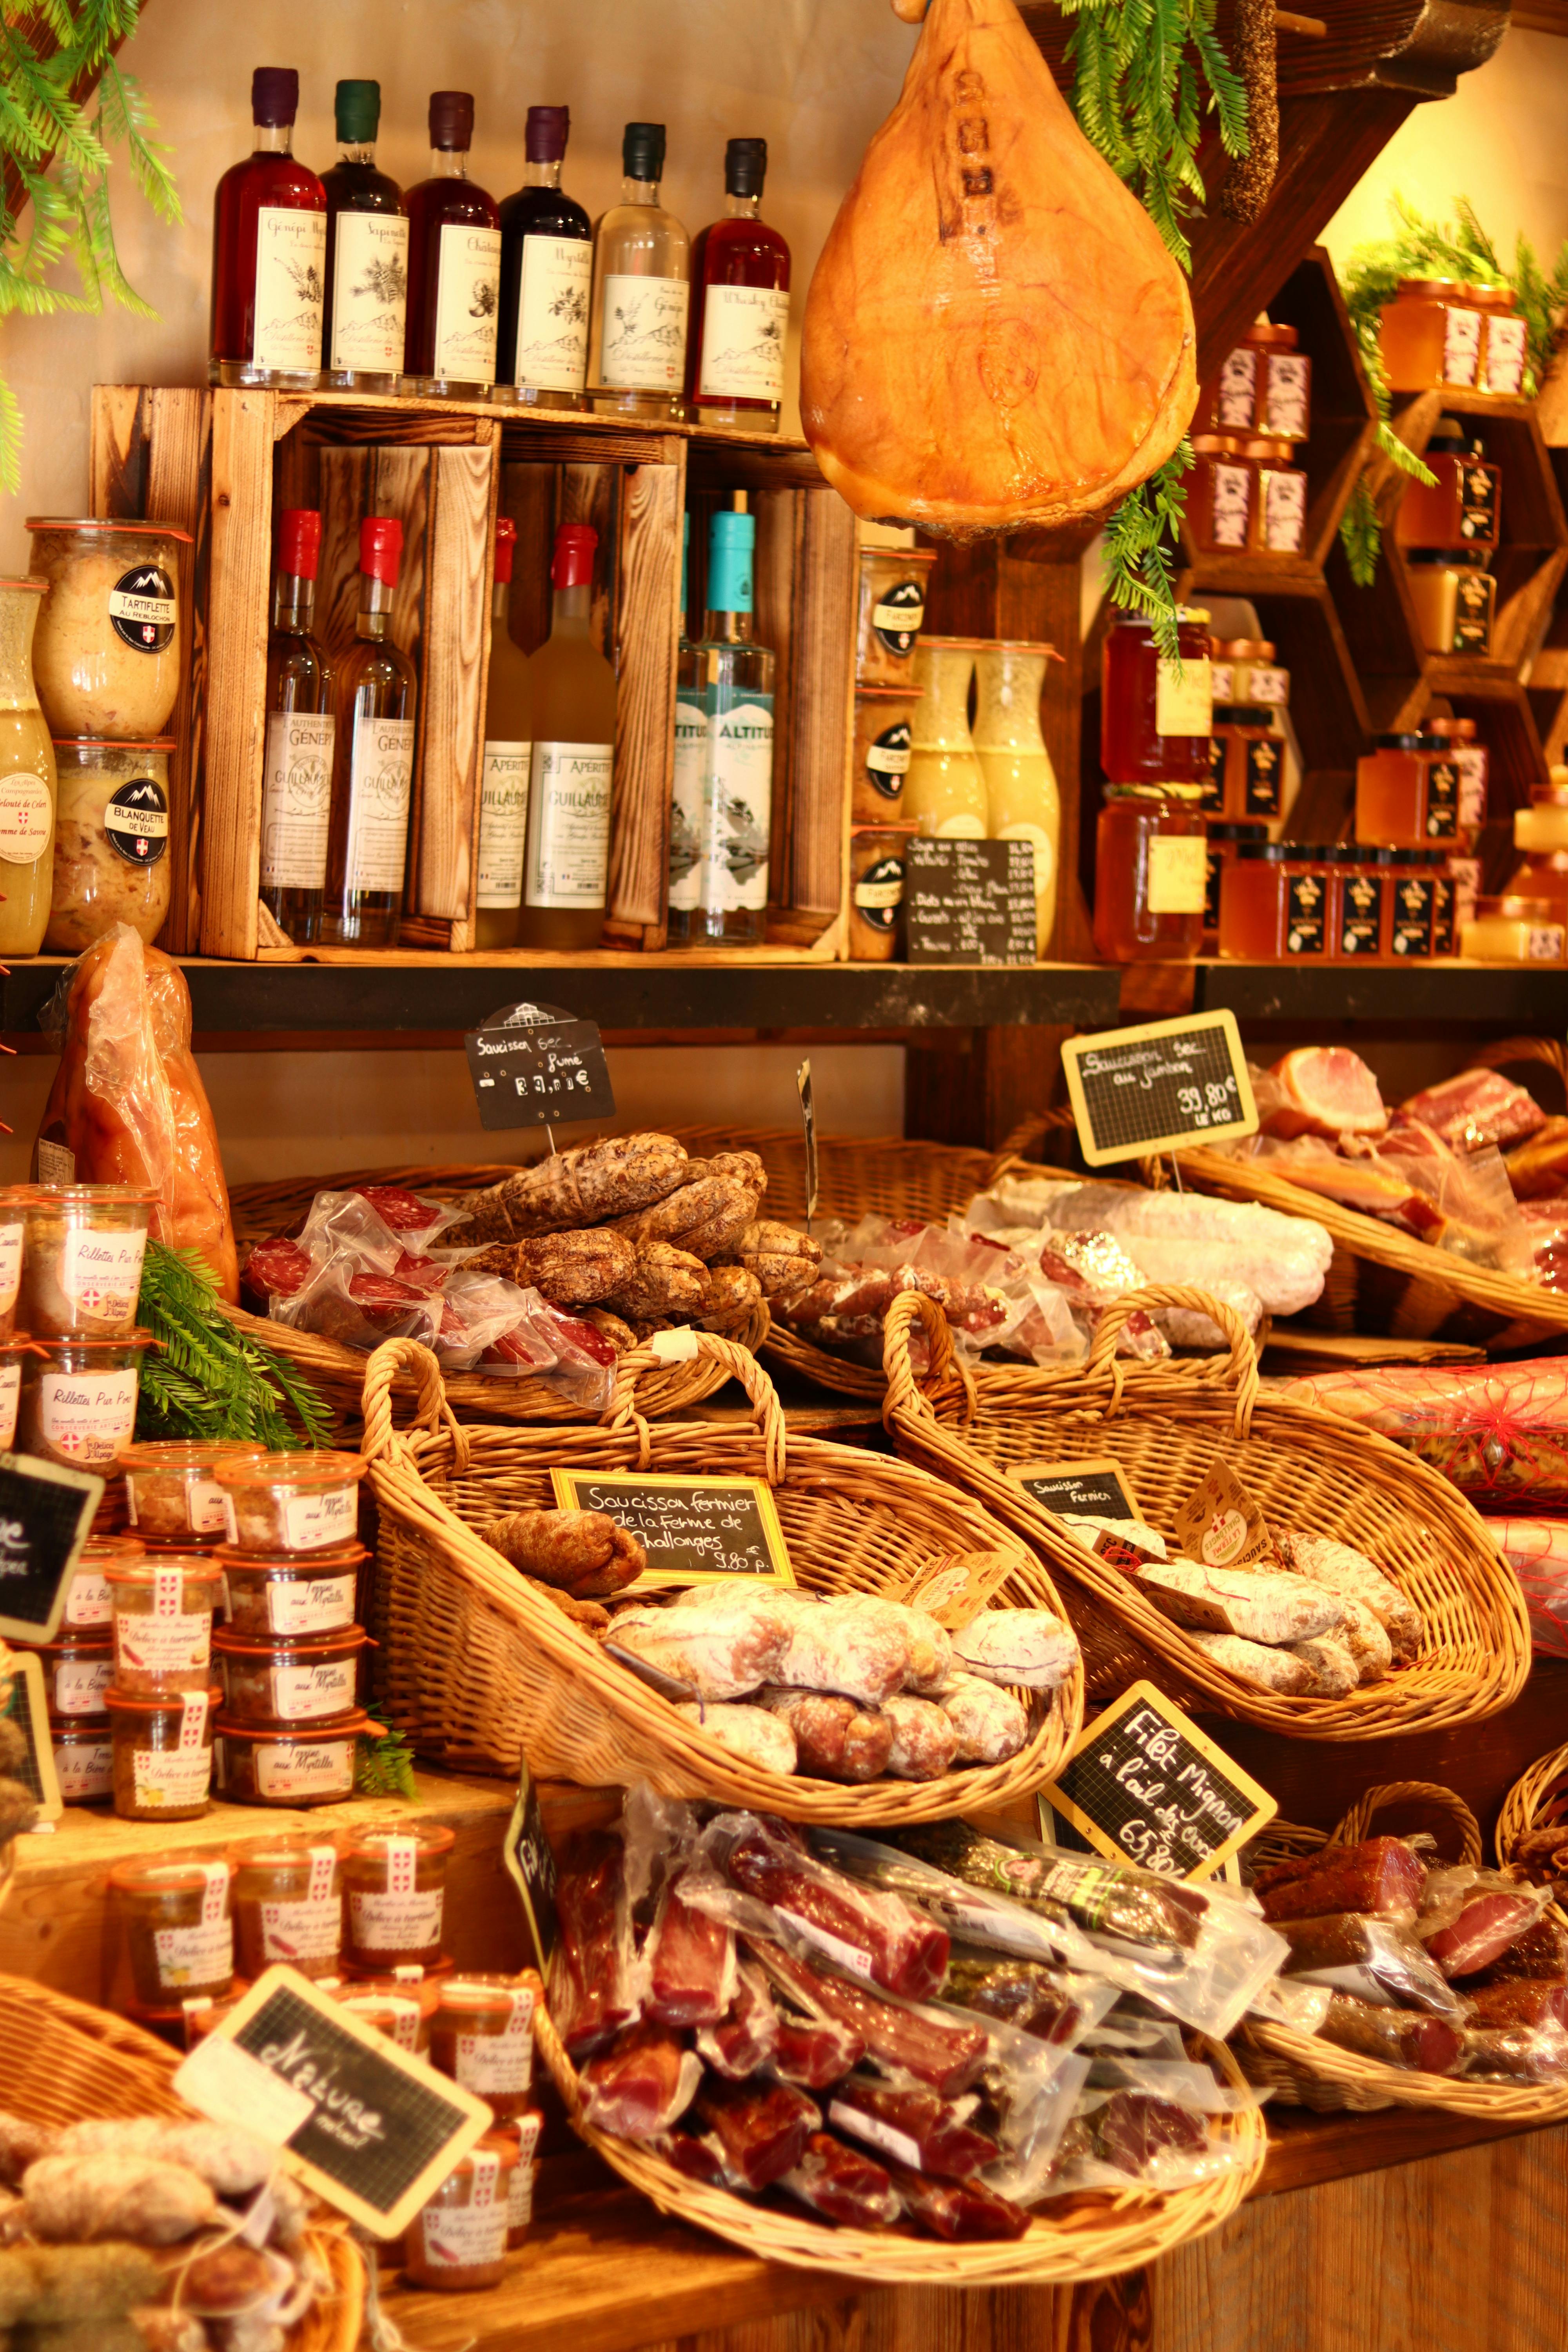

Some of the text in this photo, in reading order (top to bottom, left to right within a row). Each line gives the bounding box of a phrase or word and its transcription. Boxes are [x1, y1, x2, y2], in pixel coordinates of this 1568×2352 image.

[268, 218, 306, 238] Génépi
[122, 595, 170, 614] TARTIFLETTE
[133, 612, 170, 622] REBLOCHON
[23, 799, 31, 808] de
[114, 806, 164, 824] BLANQUETTE
[19, 826, 27, 836] de
[28, 827, 47, 836] Savoie
[139, 822, 155, 833] VEAU
[477, 1037, 532, 1056] Saucisson
[1082, 1051, 1162, 1078] Saucisson
[1113, 1060, 1193, 1090] au jambon
[77, 1244, 132, 1264] Rillettes Pur
[53, 1389, 132, 1406] Rillettes Pur Porc
[1033, 1481, 1083, 1494] Saucisson
[589, 1487, 689, 1510] Saucisson
[305, 1512, 321, 1520] aux
[614, 1510, 744, 1531] de la Ferme de
[1204, 1515, 1241, 1551] CHALLONGES
[1212, 1537, 1232, 1557] FERME
[921, 1560, 938, 1577] SEC
[929, 1574, 951, 1596] FERME
[85, 1589, 94, 1601] la
[74, 1679, 83, 1690] la
[73, 1762, 81, 1773] la
[295, 1755, 334, 1773] Myrtilles
[1124, 1710, 1243, 1840] Filet Mignon
[259, 2027, 386, 2140] Nature
